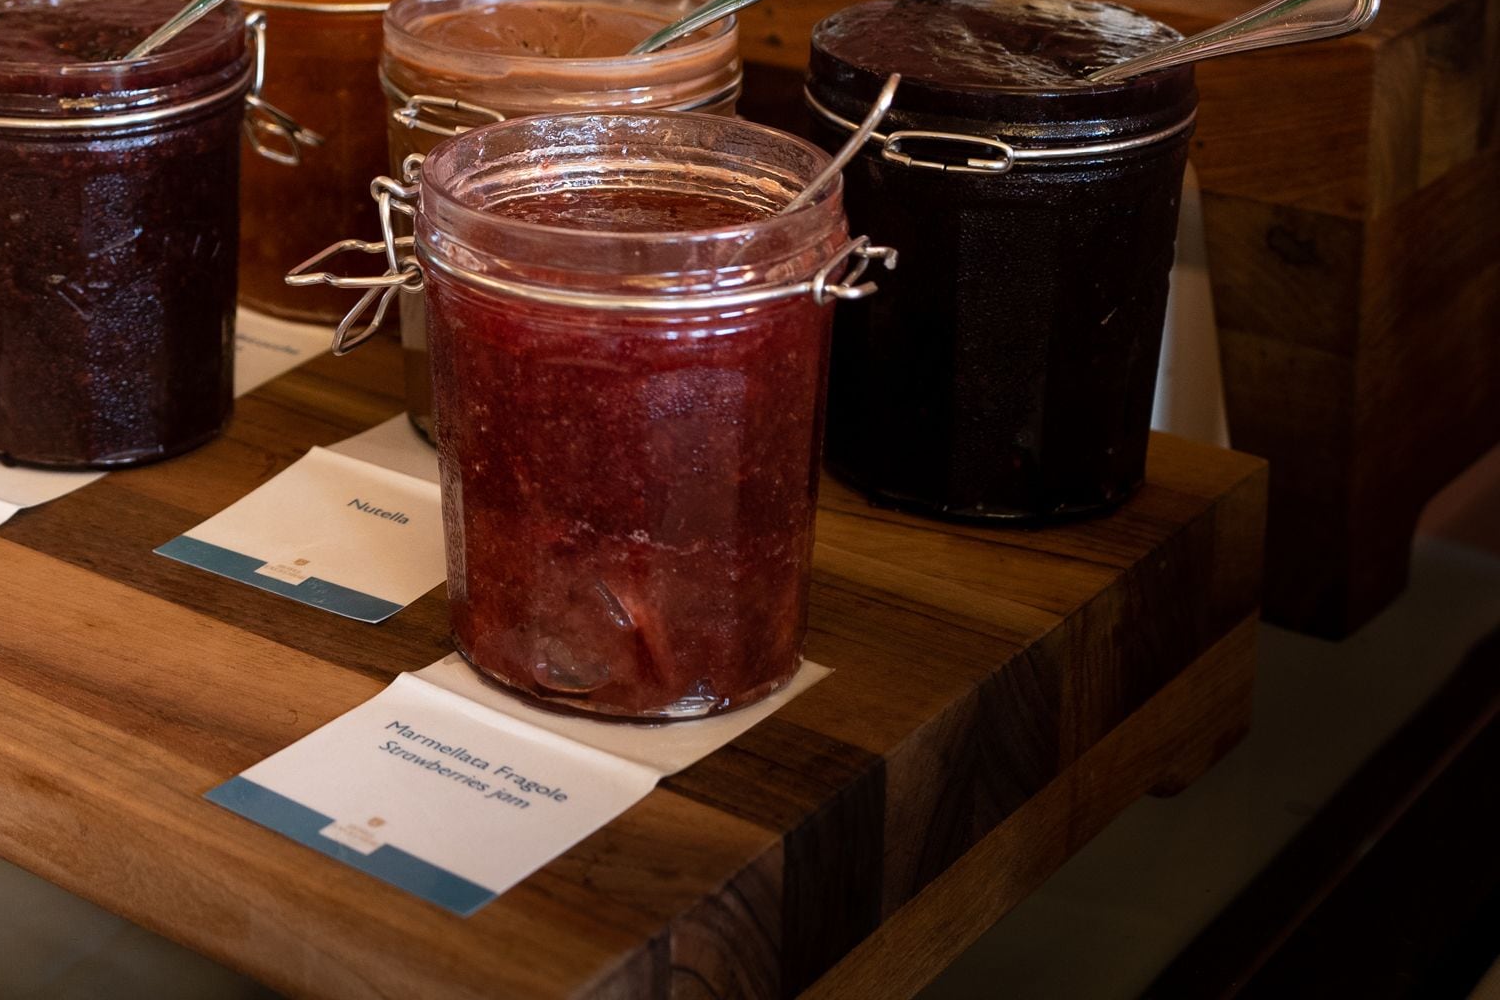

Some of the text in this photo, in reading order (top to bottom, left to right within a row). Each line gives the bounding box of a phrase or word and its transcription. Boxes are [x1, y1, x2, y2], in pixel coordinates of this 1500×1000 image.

[347, 498, 410, 525] Nutella
[379, 740, 530, 811] Strawberries jam
[385, 721, 568, 803] Marmellata Fragole
